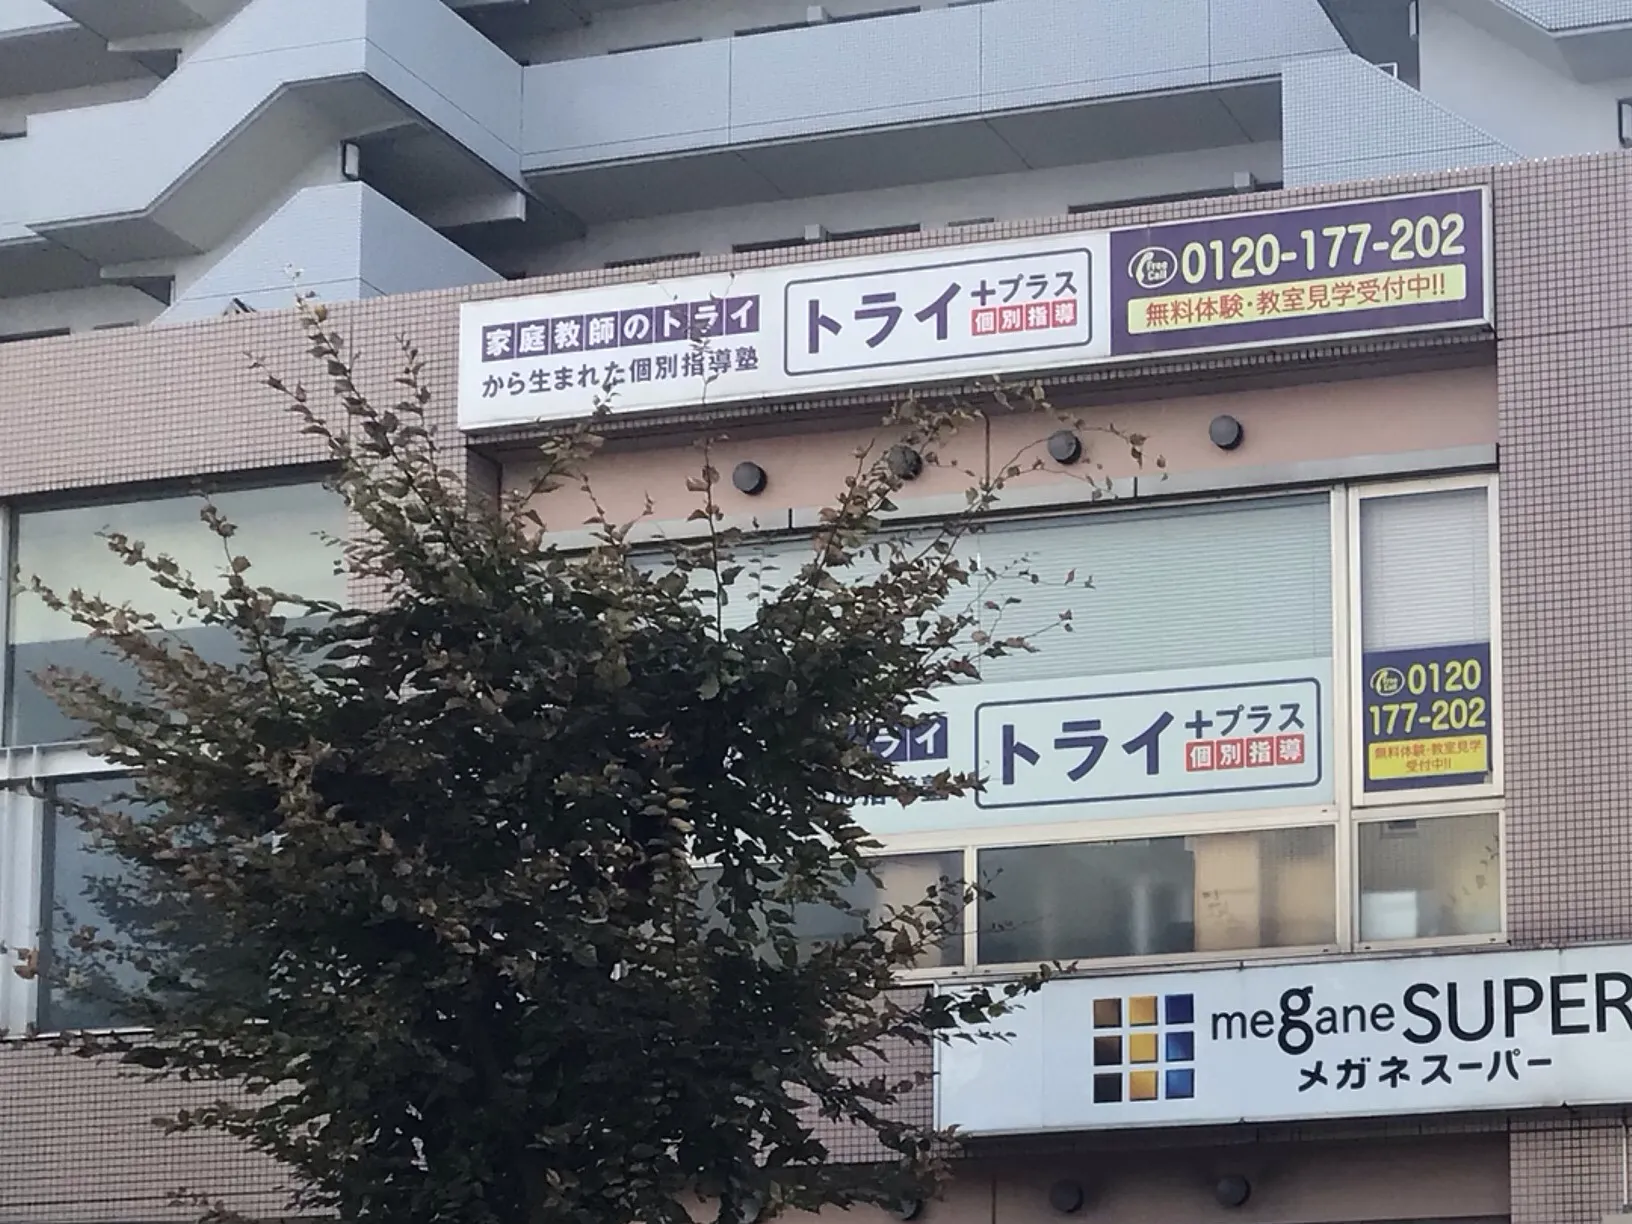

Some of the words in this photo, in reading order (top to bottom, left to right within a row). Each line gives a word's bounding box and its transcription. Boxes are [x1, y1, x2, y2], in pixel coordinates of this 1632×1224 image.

[1181, 212, 1465, 284] 0120-177-202
[484, 298, 757, 358] 家庭教師のトライ
[807, 282, 962, 354] トライ
[974, 302, 1076, 333] 個別指導
[481, 346, 760, 399] から生まれた個別指導塾
[1407, 658, 1482, 695] 0120
[1369, 696, 1486, 735] 177-202
[1002, 710, 1176, 786] トライ
[1189, 737, 1302, 769] 個別指導
[1298, 1048, 1553, 1092] メガネスーパー
